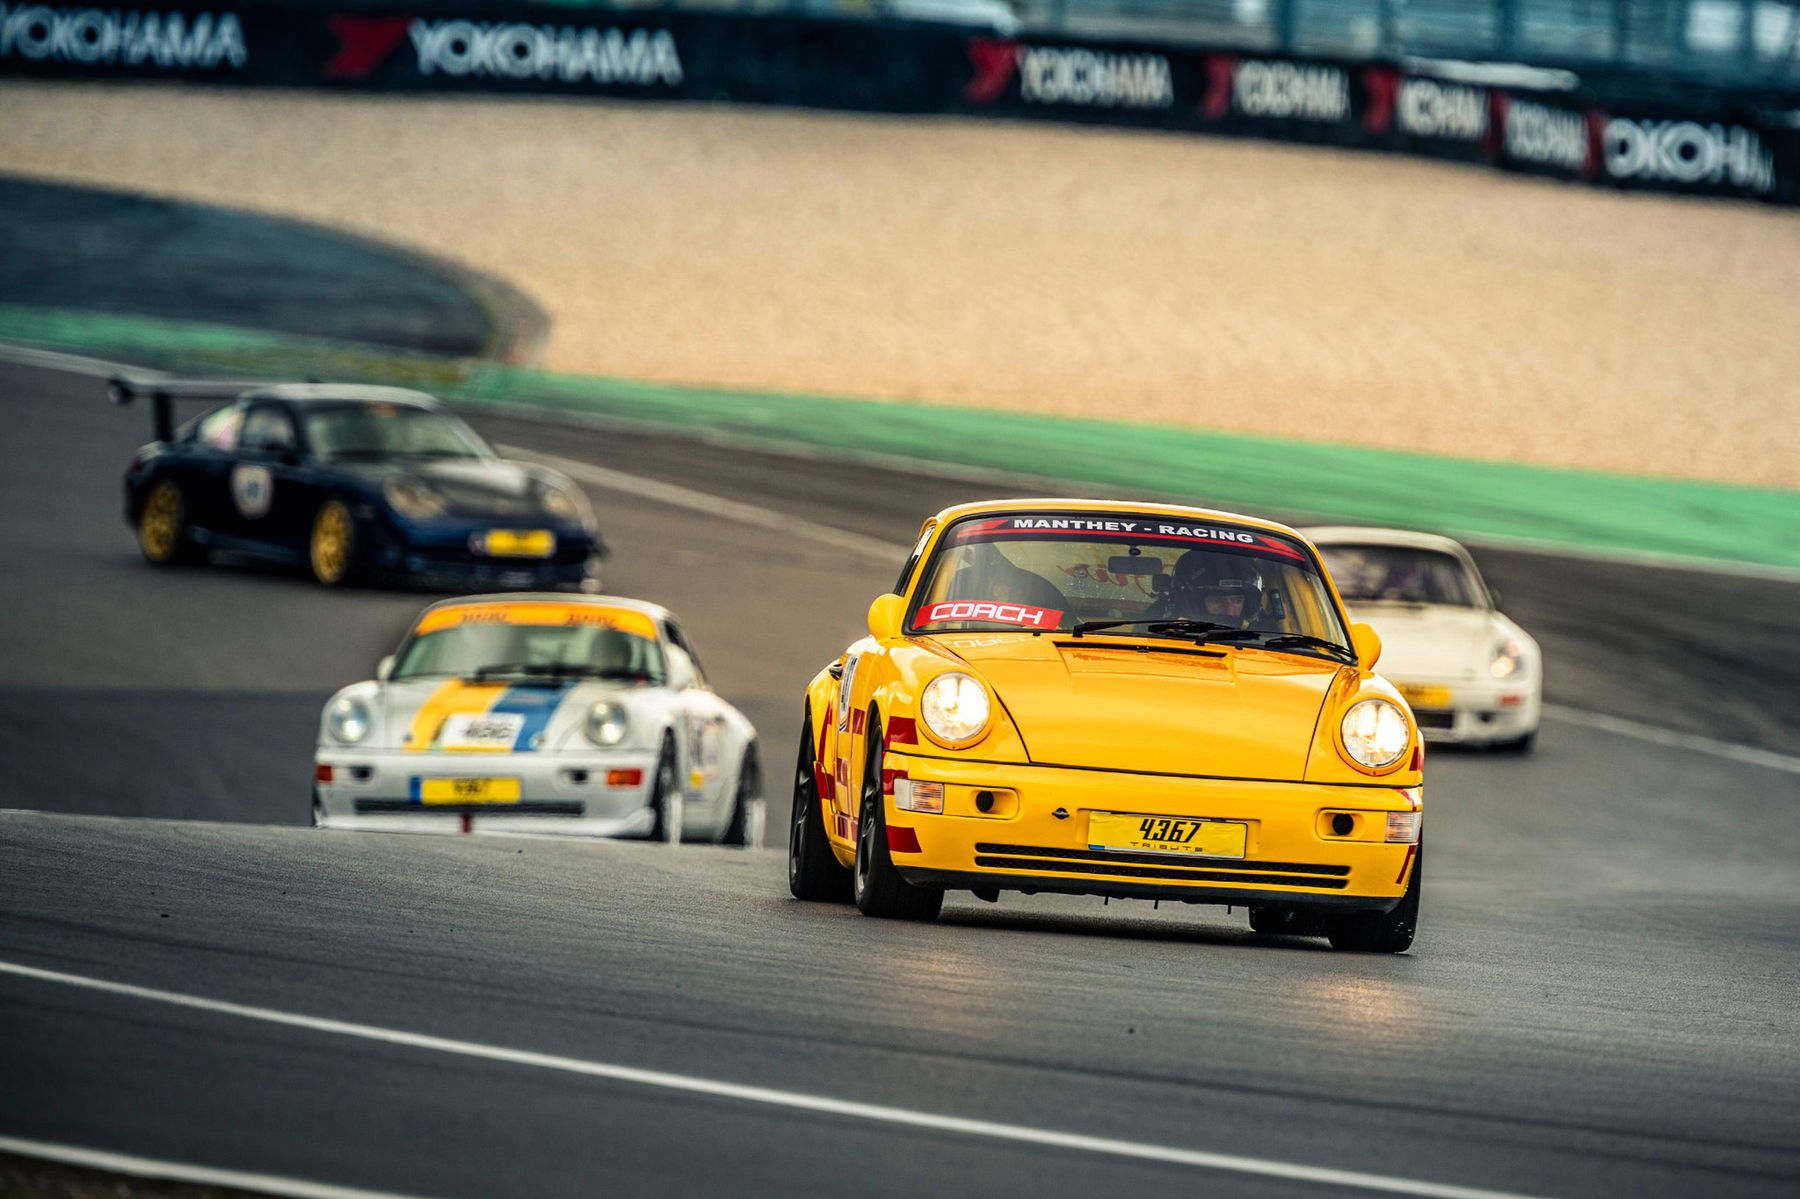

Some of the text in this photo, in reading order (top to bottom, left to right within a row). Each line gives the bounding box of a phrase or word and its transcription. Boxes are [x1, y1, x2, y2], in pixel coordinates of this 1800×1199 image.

[408, 18, 684, 86] YOKOHAMA
[1013, 519, 1137, 532] MANTHEY
[1159, 525, 1254, 543] RACING
[930, 602, 1044, 625] COACH
[1139, 818, 1202, 843] 4367
[1130, 842, 1203, 852] TRIBUTE
